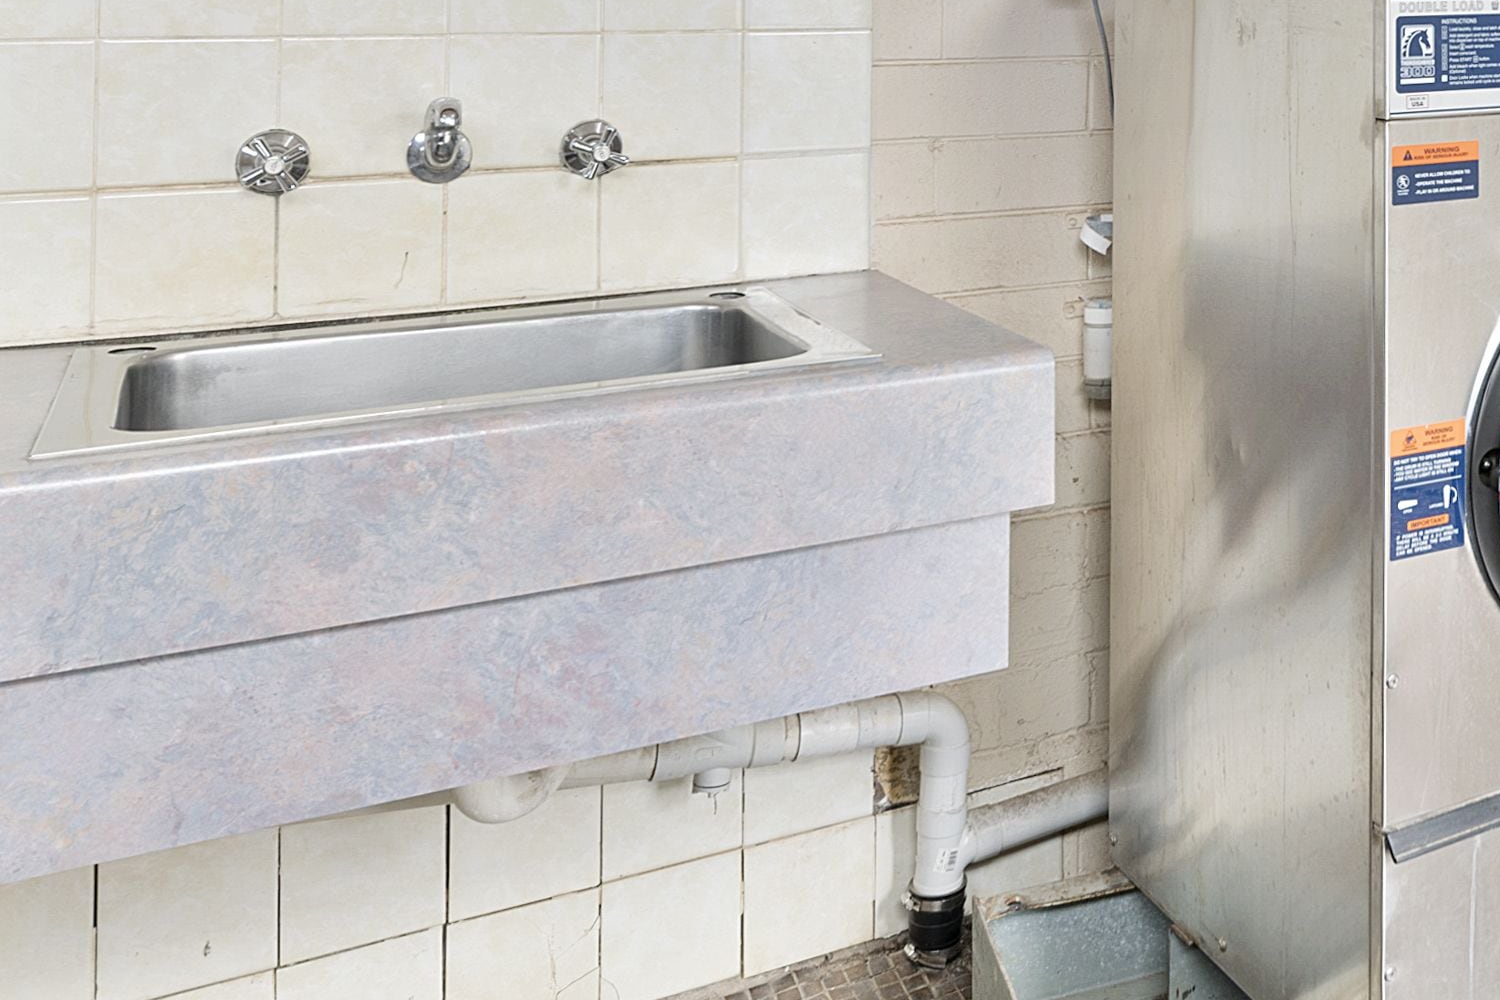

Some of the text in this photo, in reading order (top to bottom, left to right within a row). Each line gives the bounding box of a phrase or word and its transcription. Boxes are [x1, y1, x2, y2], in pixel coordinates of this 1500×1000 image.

[1400, 0, 1484, 12] DOUBLE LOAD
[1425, 426, 1453, 436] WARNING
[1411, 516, 1446, 528] IMPORTANT
